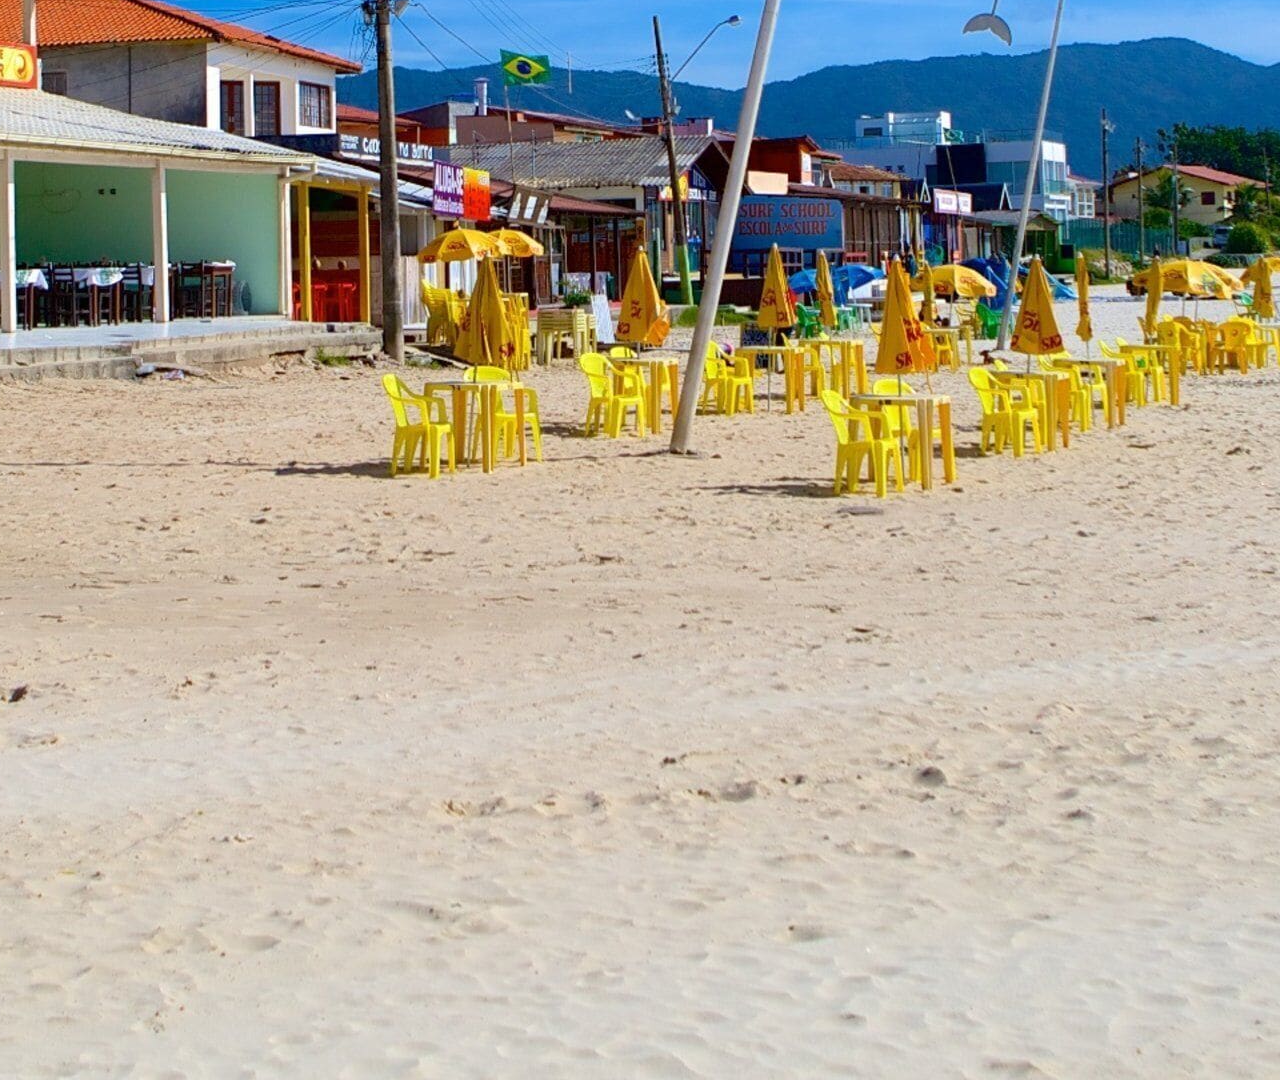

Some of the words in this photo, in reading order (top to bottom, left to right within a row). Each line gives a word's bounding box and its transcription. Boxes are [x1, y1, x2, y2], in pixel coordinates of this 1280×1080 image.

[739, 203, 776, 218] SURF
[780, 202, 835, 219] SCHOOL
[739, 221, 783, 236] ESCOLA
[794, 221, 828, 236] SURF
